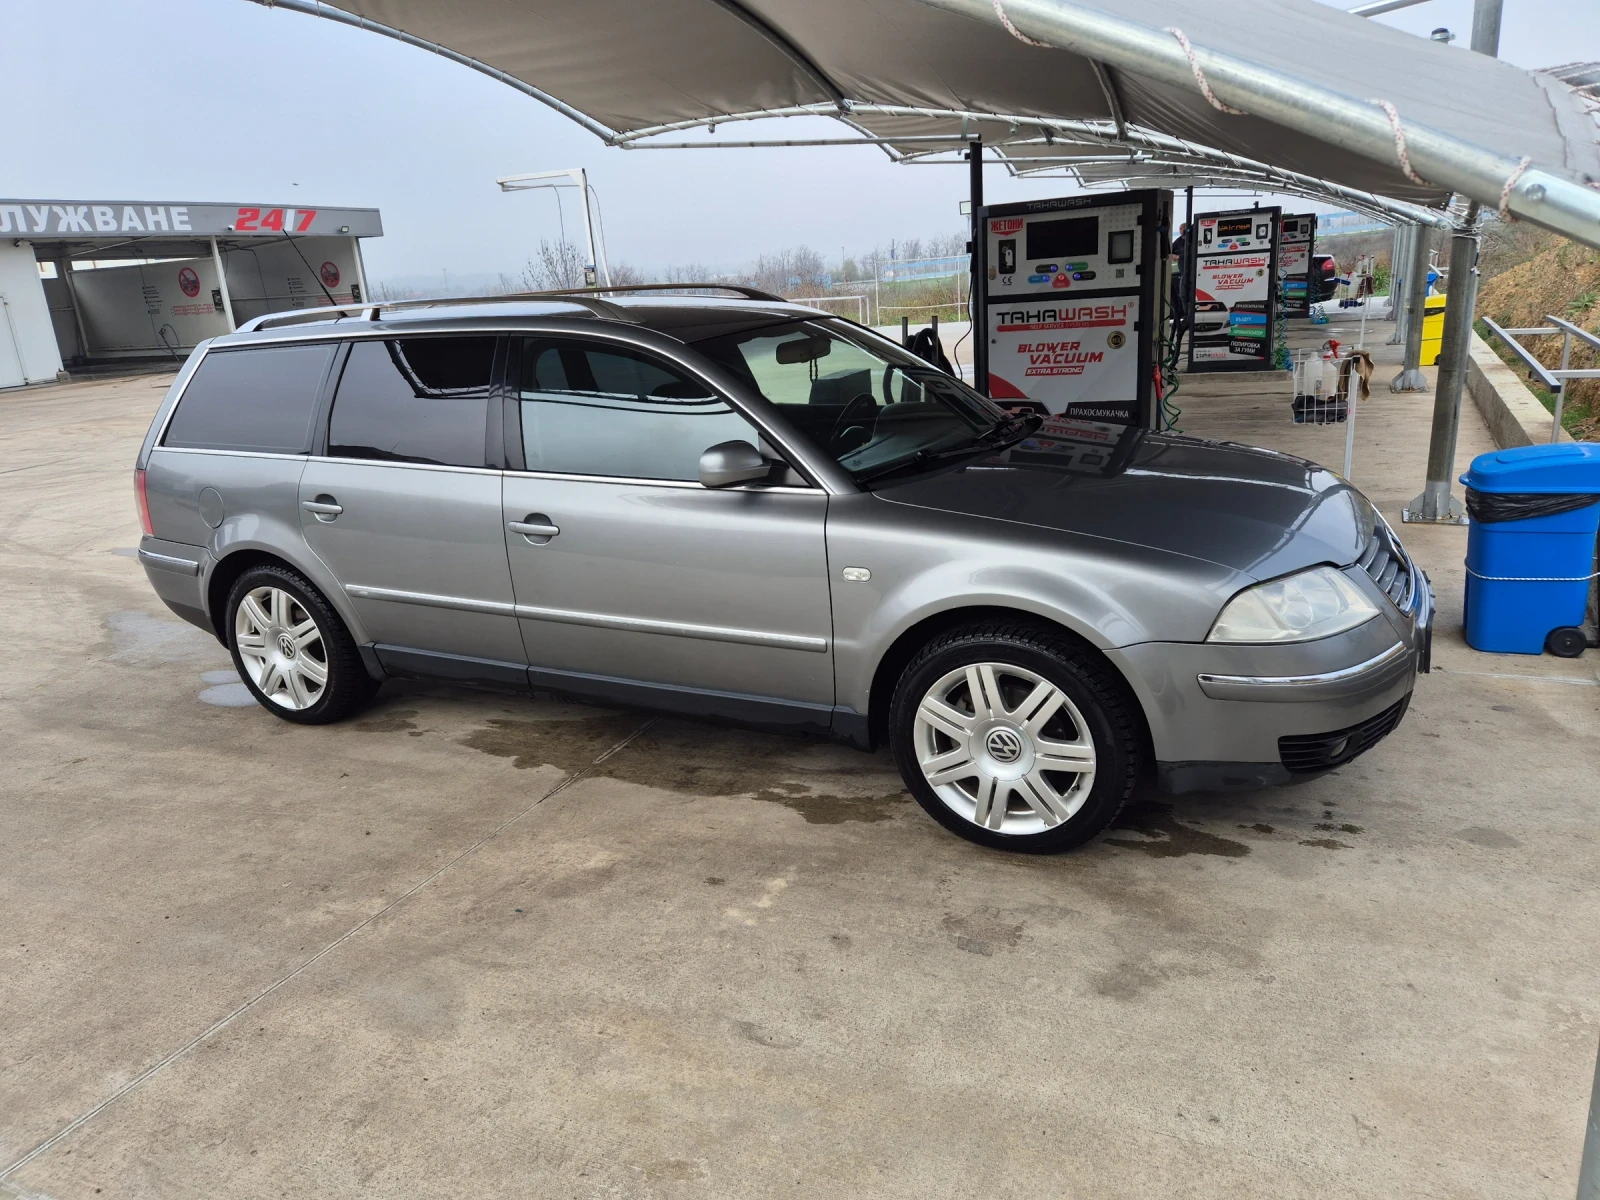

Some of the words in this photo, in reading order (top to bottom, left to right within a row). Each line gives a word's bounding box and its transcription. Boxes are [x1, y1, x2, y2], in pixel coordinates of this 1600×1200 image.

[1027, 197, 1092, 211] TAHAWASH
[0, 205, 192, 233] ЛУЖВАНЕ
[990, 218, 1024, 232] ЖЕТОНИ
[1202, 257, 1266, 266] TAHAWASH
[996, 304, 1127, 324] TAHAWASH
[1017, 341, 1081, 353] BLOWER
[1029, 351, 1104, 365] VACUUM
[1026, 367, 1052, 375] EXTRA
[1052, 366, 1083, 374] STRONG
[1070, 407, 1129, 418] ПРАХОСМУКАЧКА
